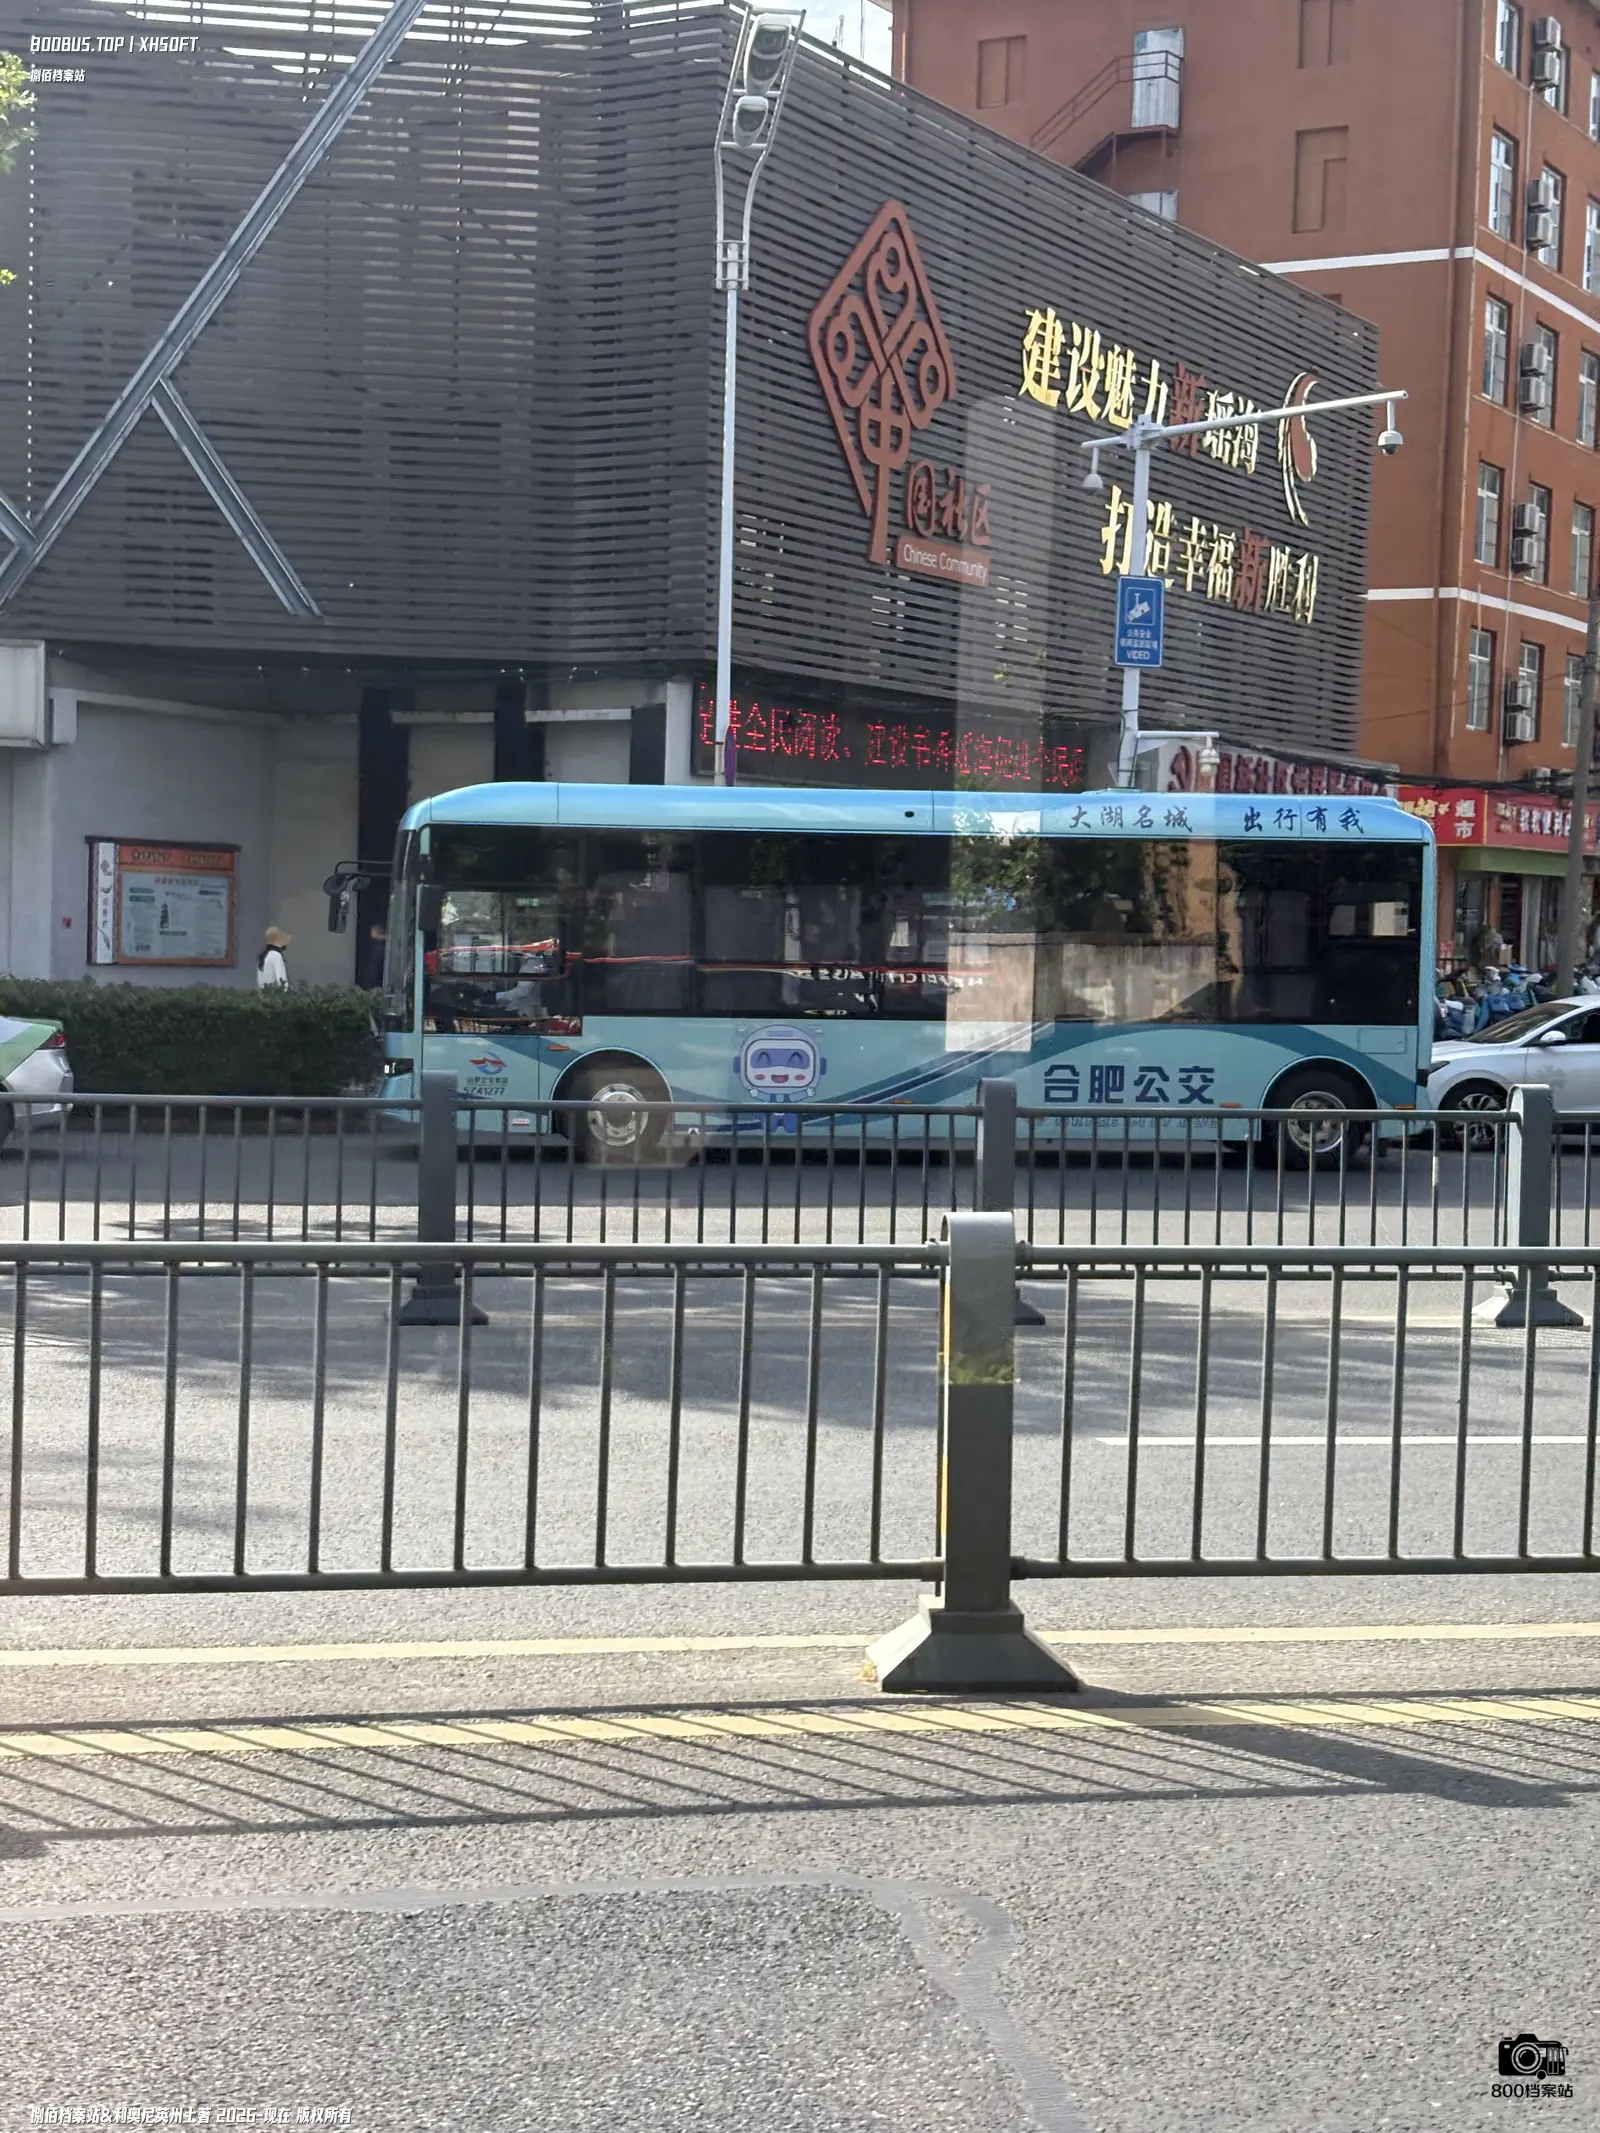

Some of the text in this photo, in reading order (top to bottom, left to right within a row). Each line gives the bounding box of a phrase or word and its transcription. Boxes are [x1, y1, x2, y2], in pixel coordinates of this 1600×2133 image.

[1018, 306, 1262, 475] 建设魅力新瑶海
[903, 544, 988, 585] Chinese Community
[1100, 485, 1319, 625] 打造幸福新胜利
[1126, 650, 1150, 660] VIDEO
[1068, 804, 1193, 833] 大湖名城
[1243, 806, 1365, 835] 出行有我
[1454, 799, 1477, 839] 超市
[1043, 1064, 1215, 1104] 合肥公交
